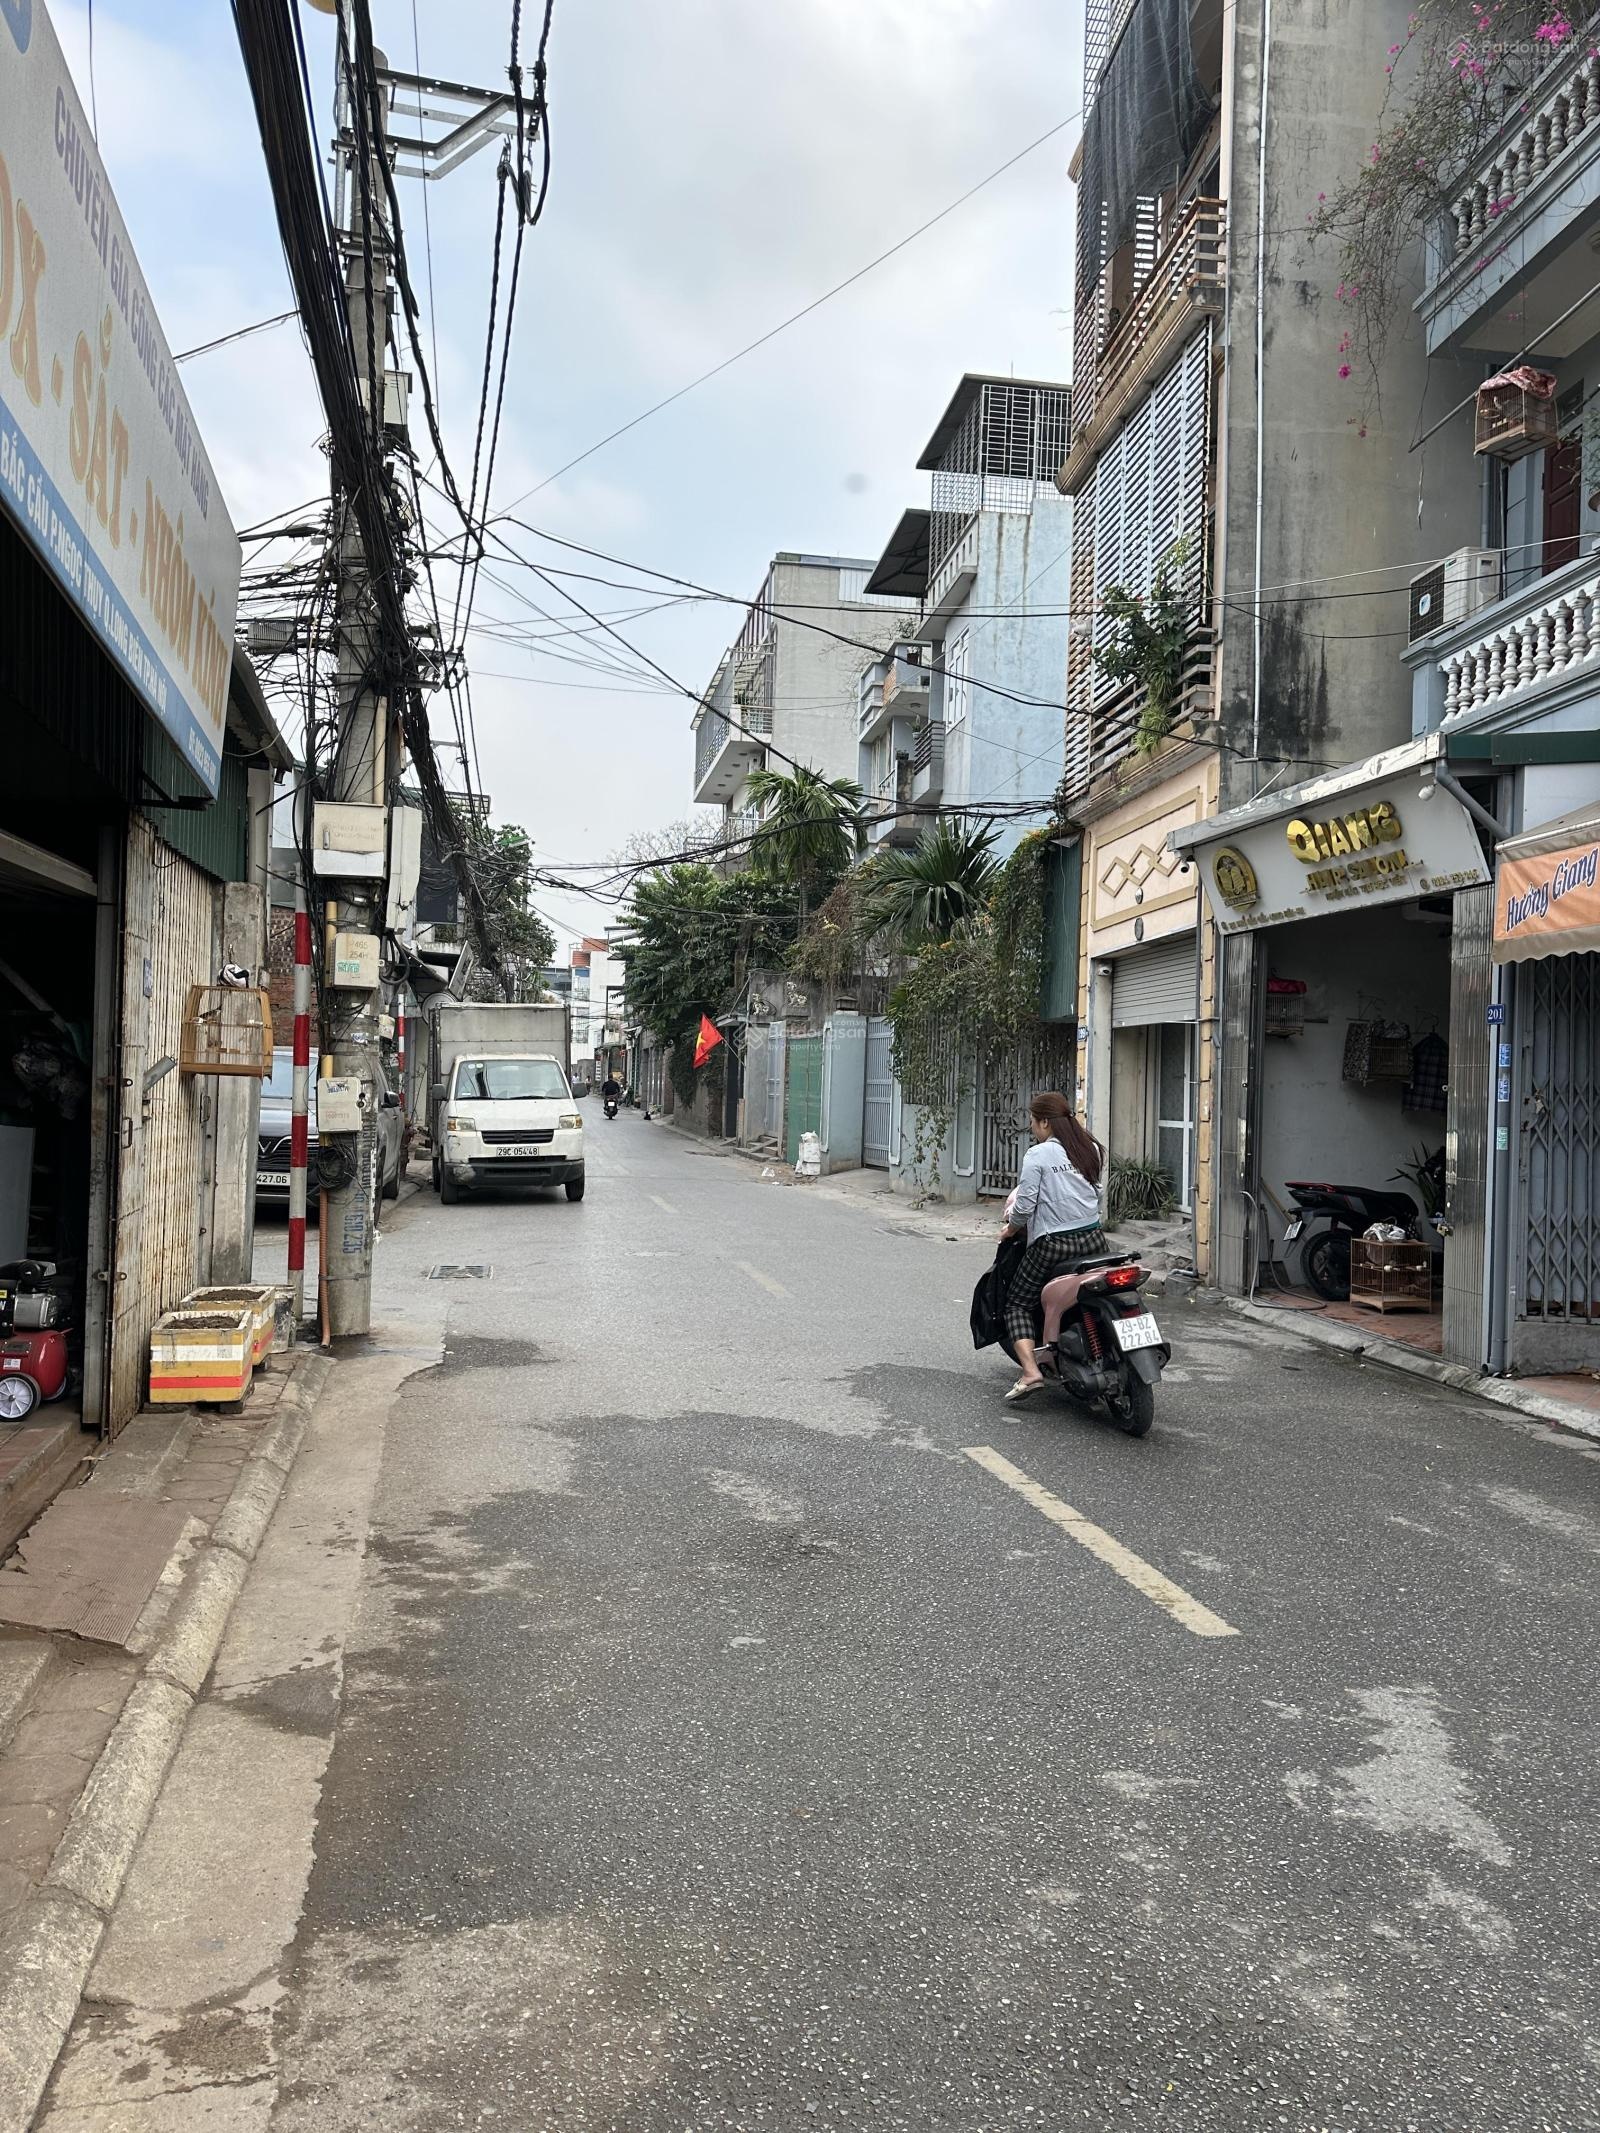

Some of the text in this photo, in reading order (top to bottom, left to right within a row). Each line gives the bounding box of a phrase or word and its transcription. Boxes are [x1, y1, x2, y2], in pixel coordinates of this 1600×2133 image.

[54, 86, 109, 268] CHUYÊN
[111, 233, 129, 323] GIA
[130, 288, 158, 392] CÔNG
[156, 363, 177, 437] CÁC
[0, 431, 26, 504] BẮC
[69, 303, 129, 550] SẮT
[139, 476, 195, 674] NHÔM
[192, 590, 229, 731] KÍNH
[1286, 801, 1402, 864] QIANG
[1552, 848, 1599, 900] Giang
[1487, 1008, 1503, 1021] 201
